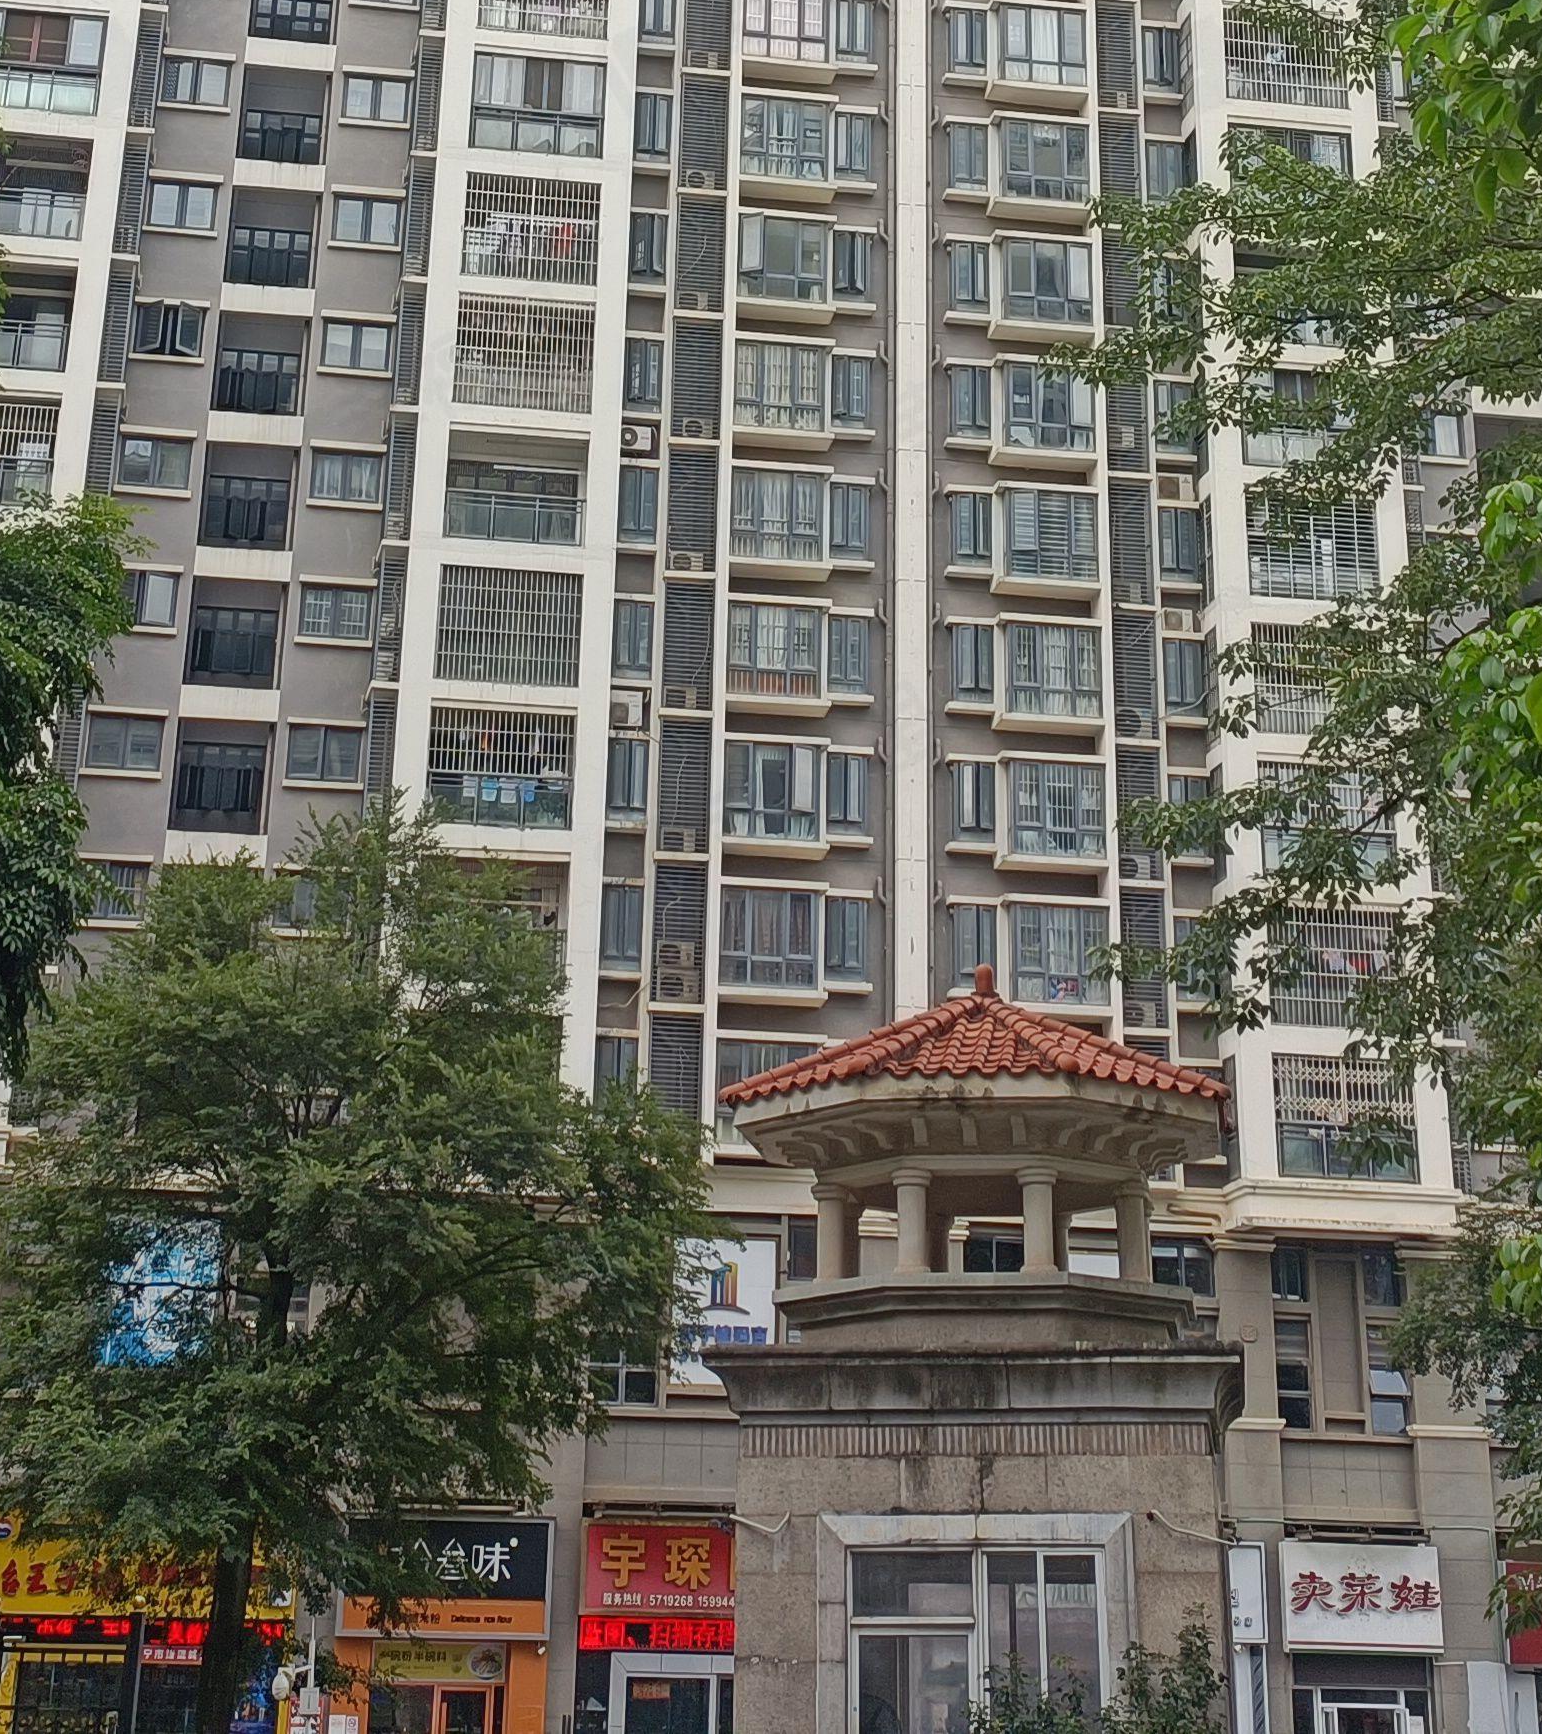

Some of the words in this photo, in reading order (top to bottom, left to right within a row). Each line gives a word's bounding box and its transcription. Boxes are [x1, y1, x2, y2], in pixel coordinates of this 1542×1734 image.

[600, 1532, 735, 1592] 宇琛
[649, 1595, 694, 1607] 5719268
[1290, 1570, 1441, 1615] 卖菜娃
